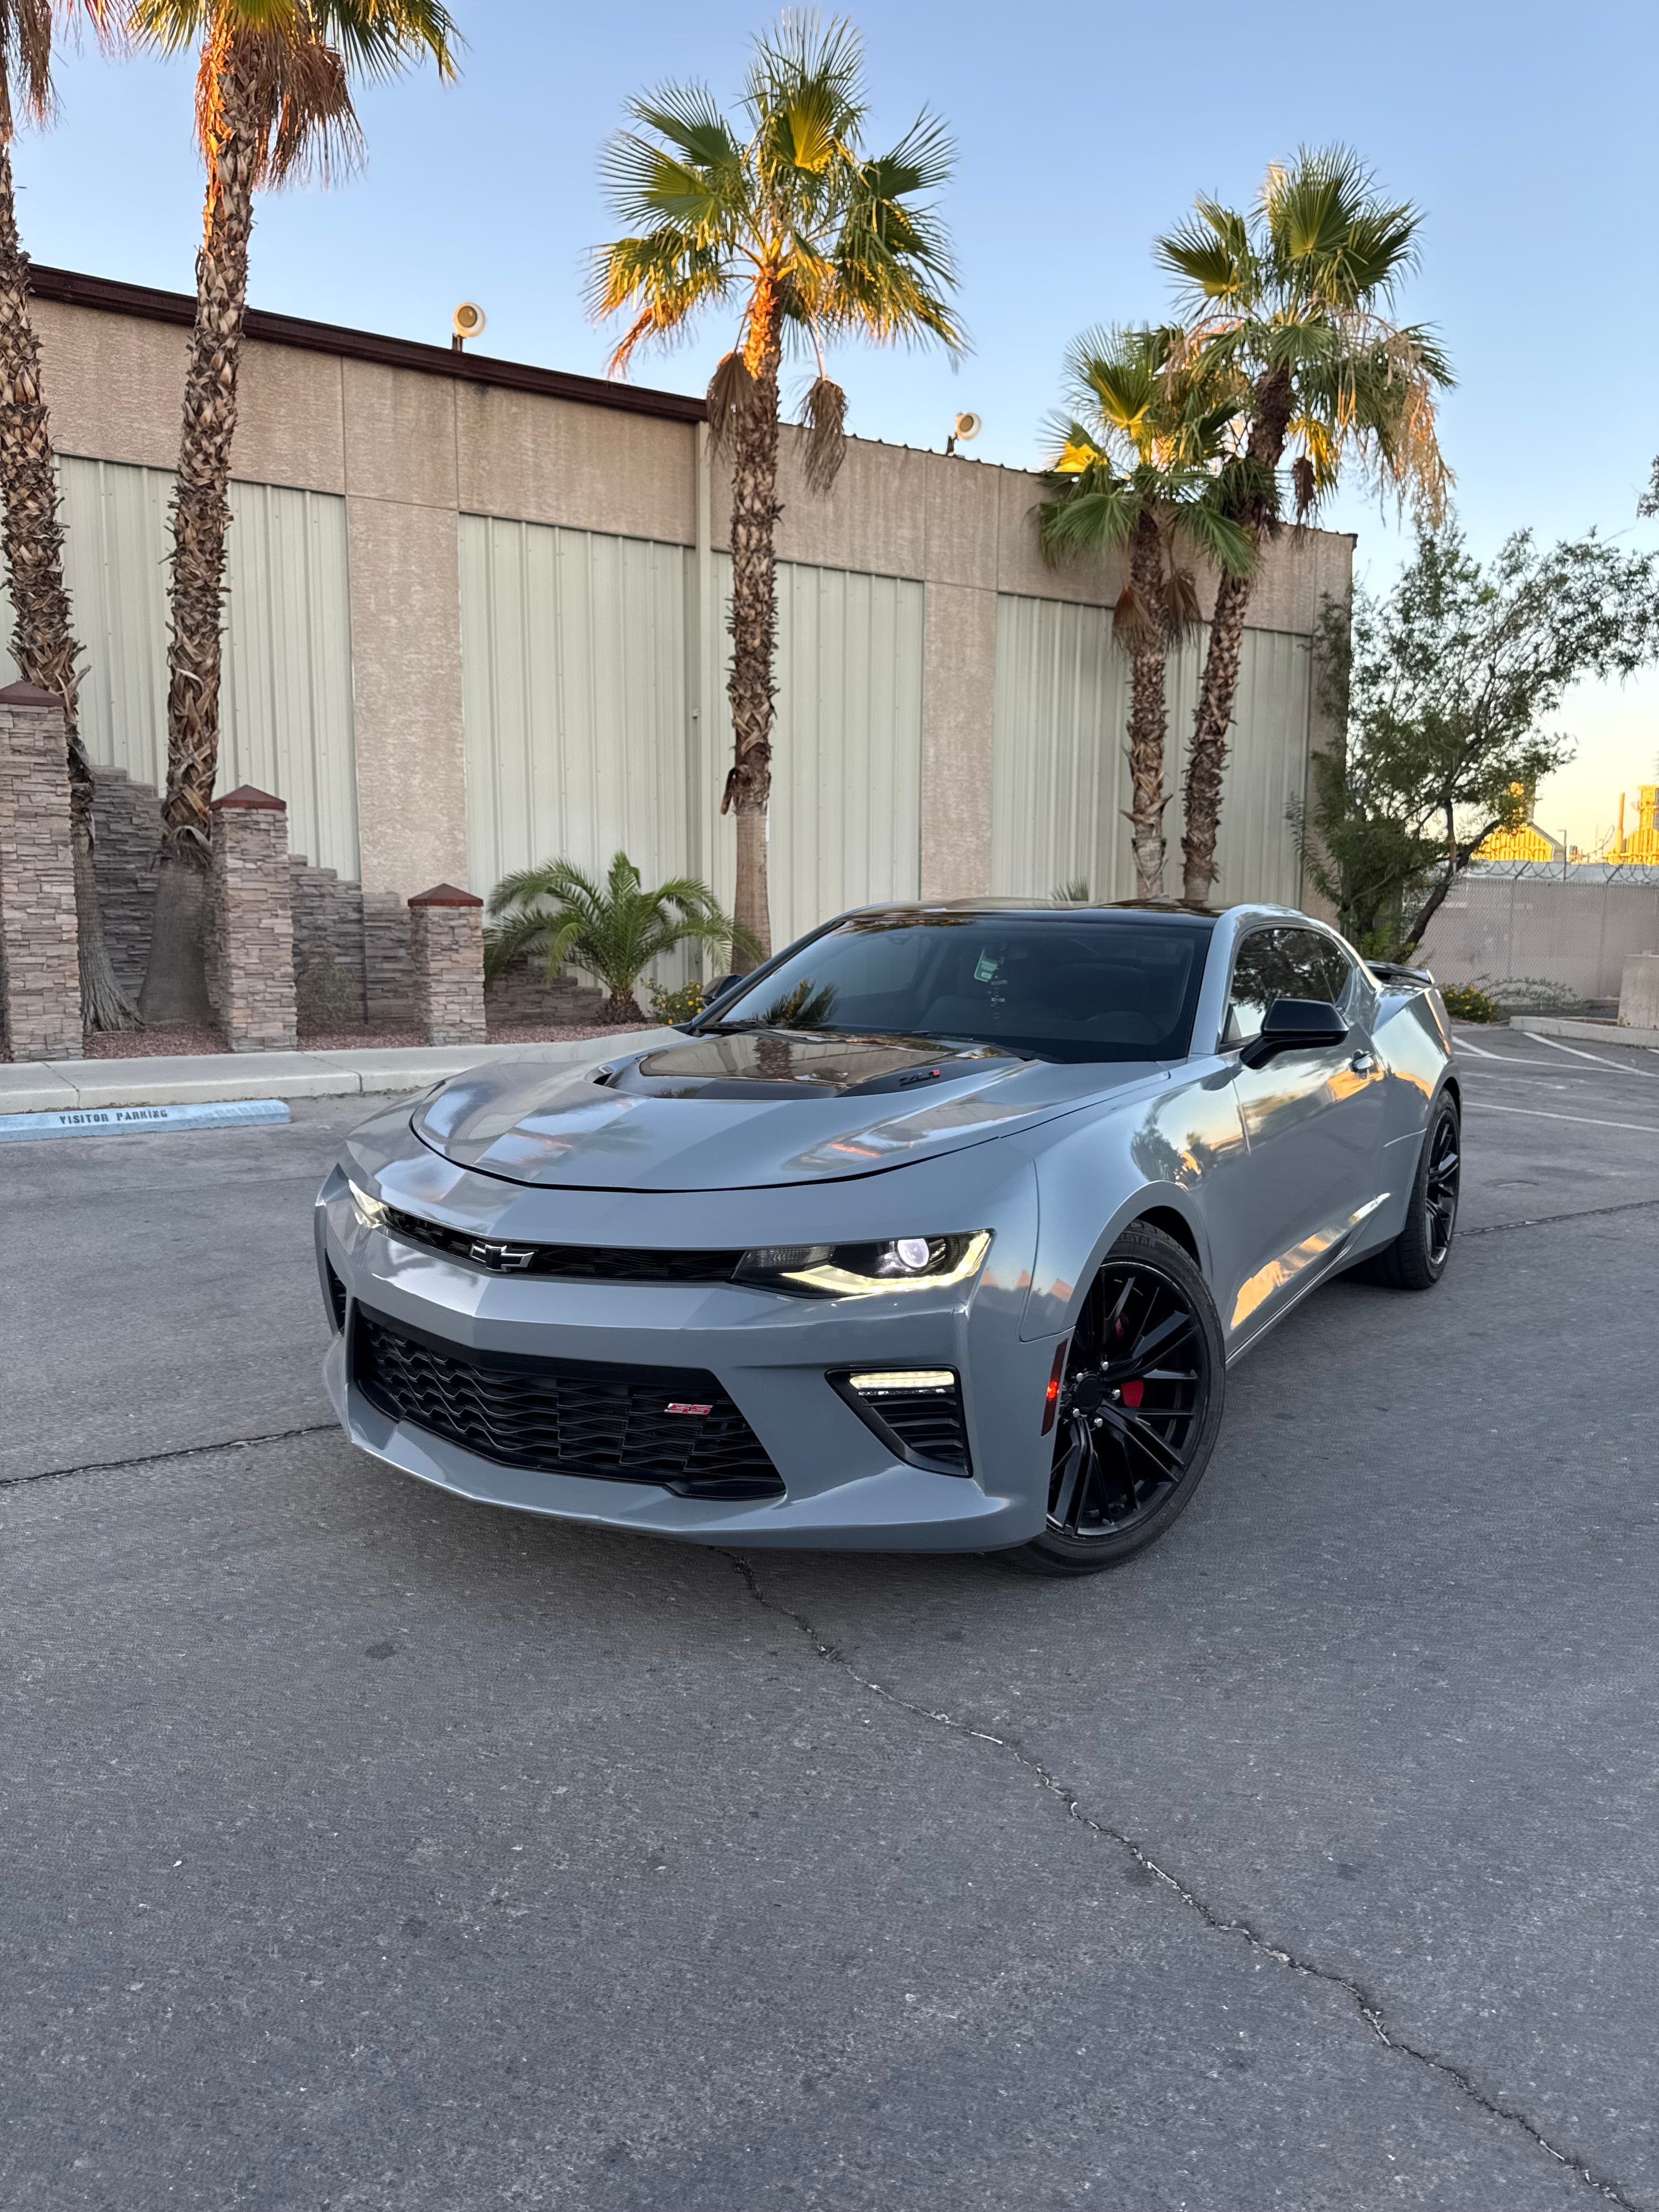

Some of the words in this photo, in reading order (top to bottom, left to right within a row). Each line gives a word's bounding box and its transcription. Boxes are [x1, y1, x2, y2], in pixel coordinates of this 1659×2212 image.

[60, 1113, 109, 1124] VISITOR
[116, 1109, 168, 1122] PARKING
[664, 1403, 713, 1415] SS
